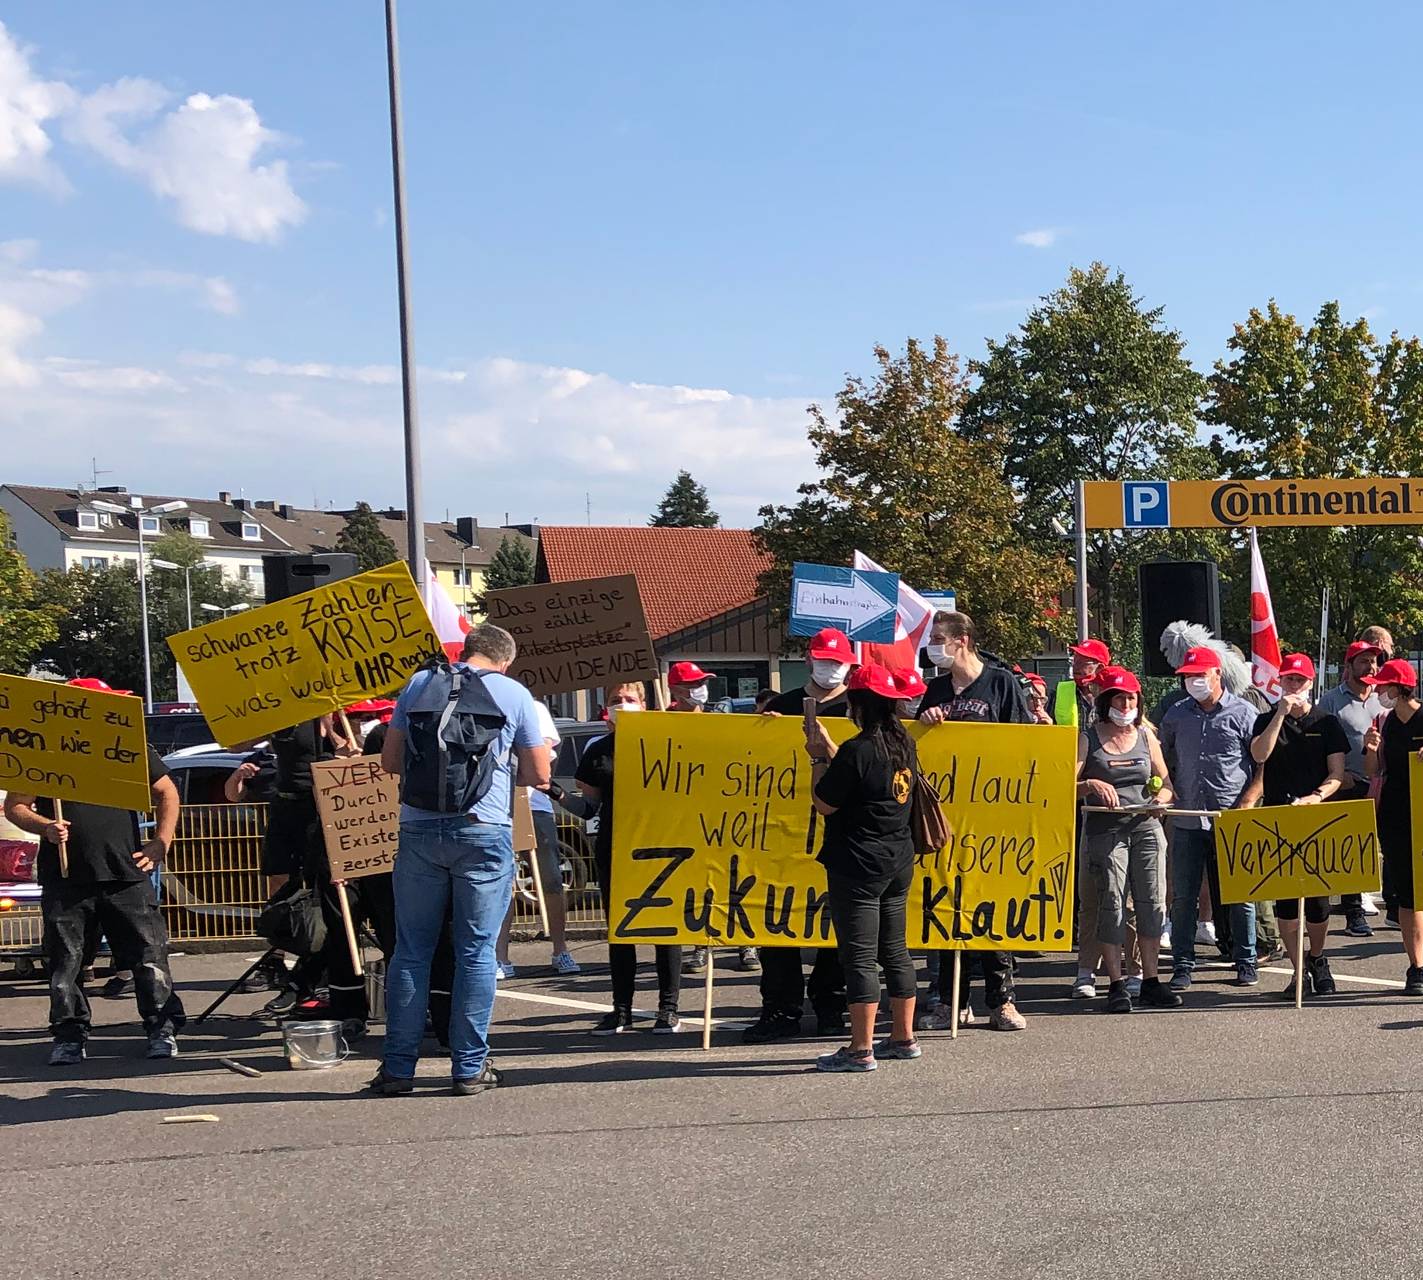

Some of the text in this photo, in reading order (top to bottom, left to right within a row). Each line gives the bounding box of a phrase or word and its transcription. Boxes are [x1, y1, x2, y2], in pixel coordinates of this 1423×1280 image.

[1133, 487, 1160, 522] P
[1211, 482, 1412, 526] Continental
[187, 582, 402, 663] schwarze Zahlen
[493, 588, 624, 619] Das einzige
[544, 609, 595, 629] zählt
[235, 597, 422, 680] trotz KRISE
[290, 667, 352, 699] wollt
[354, 651, 405, 691] IHR
[518, 650, 650, 688] DIVIDENDE
[30, 690, 91, 724] gehört
[104, 711, 134, 728] zu
[61, 730, 91, 755] wie
[104, 736, 140, 764] der
[0, 752, 76, 789] Dom
[640, 737, 705, 796] Wir
[721, 749, 797, 800] sind
[331, 788, 388, 811] Durch
[334, 810, 398, 831] werden
[340, 828, 400, 851] Existe
[700, 802, 771, 852] weil
[1219, 821, 1376, 877] Vertrauen
[615, 847, 833, 940] Zukun
